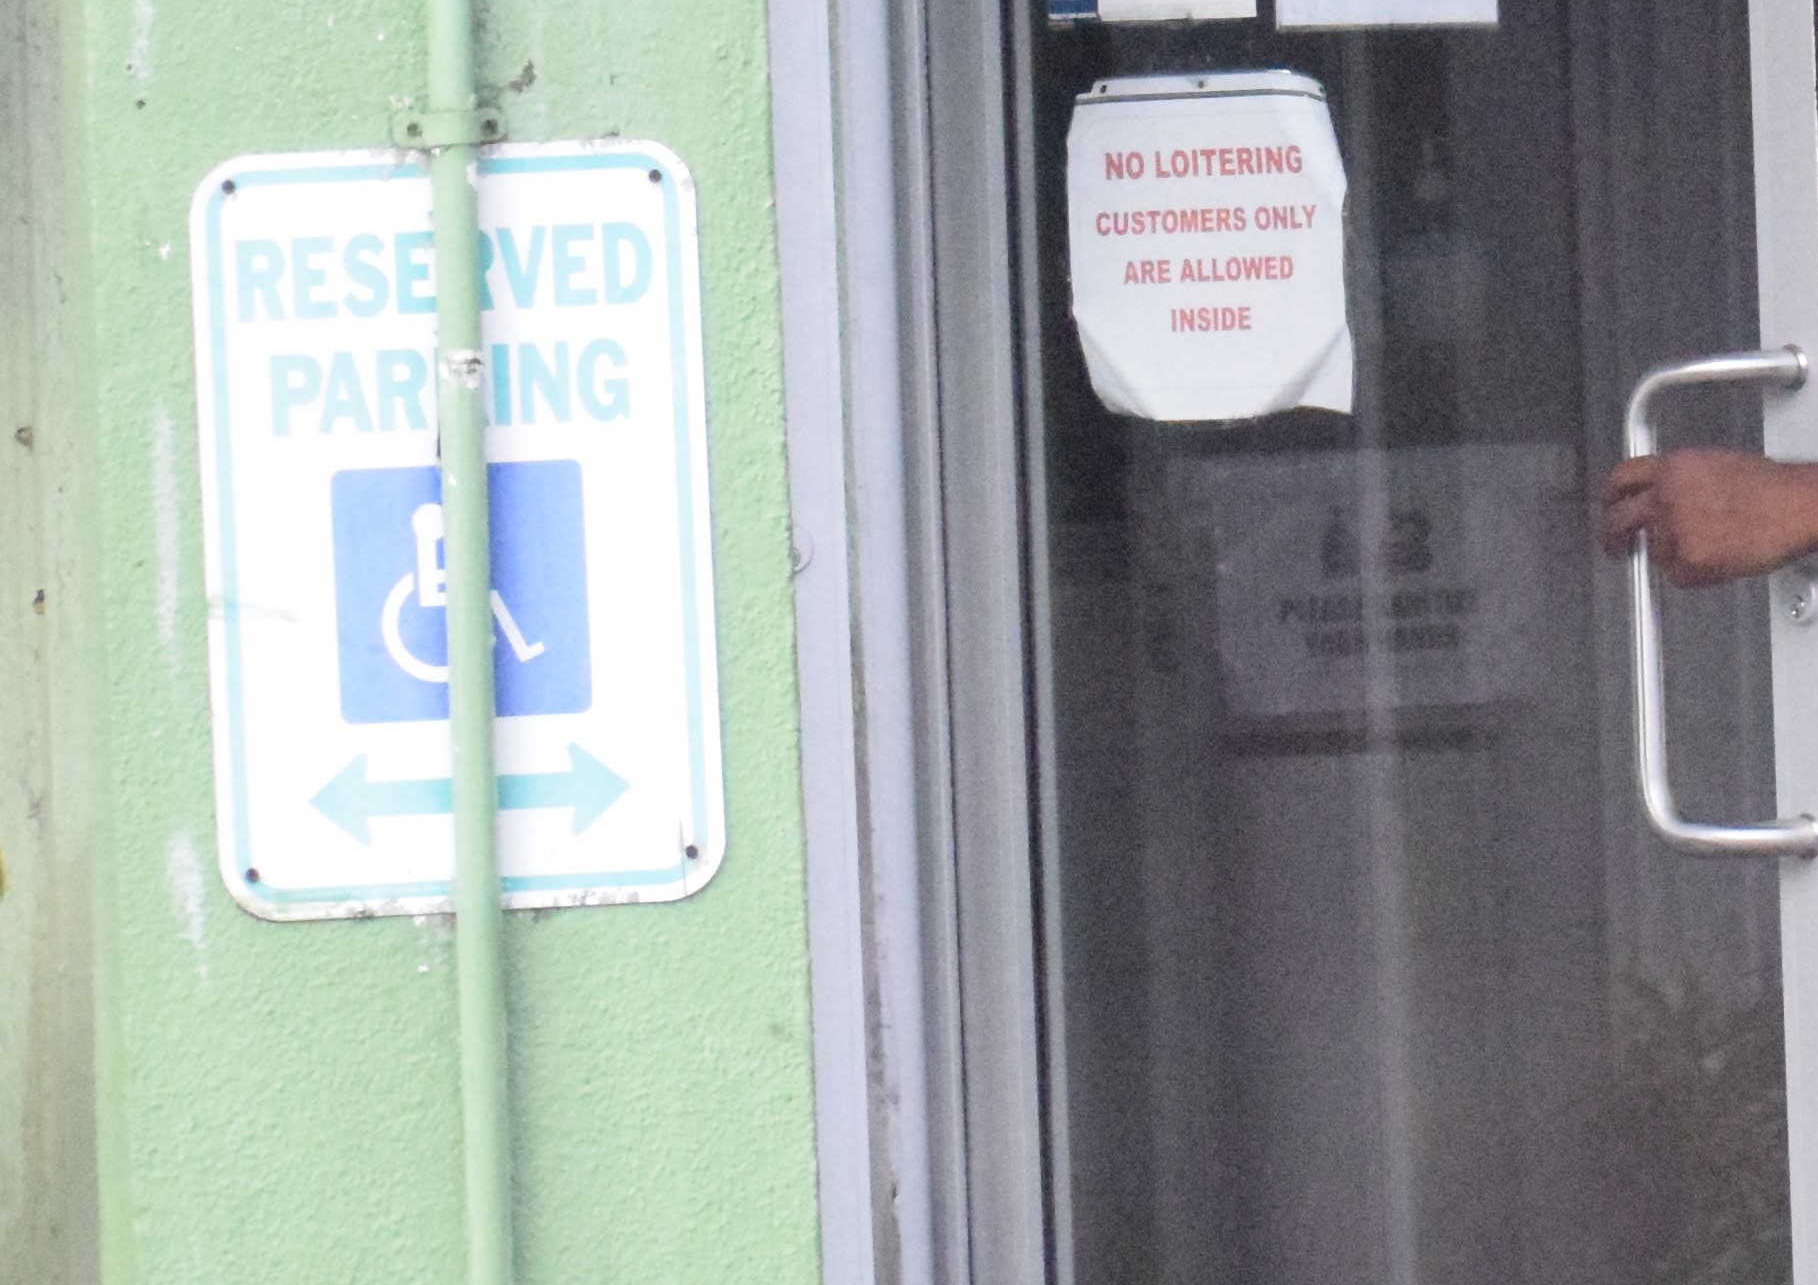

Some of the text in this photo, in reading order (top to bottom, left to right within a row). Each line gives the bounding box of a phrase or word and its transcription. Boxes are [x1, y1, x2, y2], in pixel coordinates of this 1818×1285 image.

[1104, 145, 1303, 180] NO LOITERING
[1095, 204, 1317, 236] CUSTOMERS ONLY
[1123, 255, 1293, 285] ARE ALLOWED
[1170, 306, 1252, 333] INSIDE
[269, 337, 632, 438] PARING
